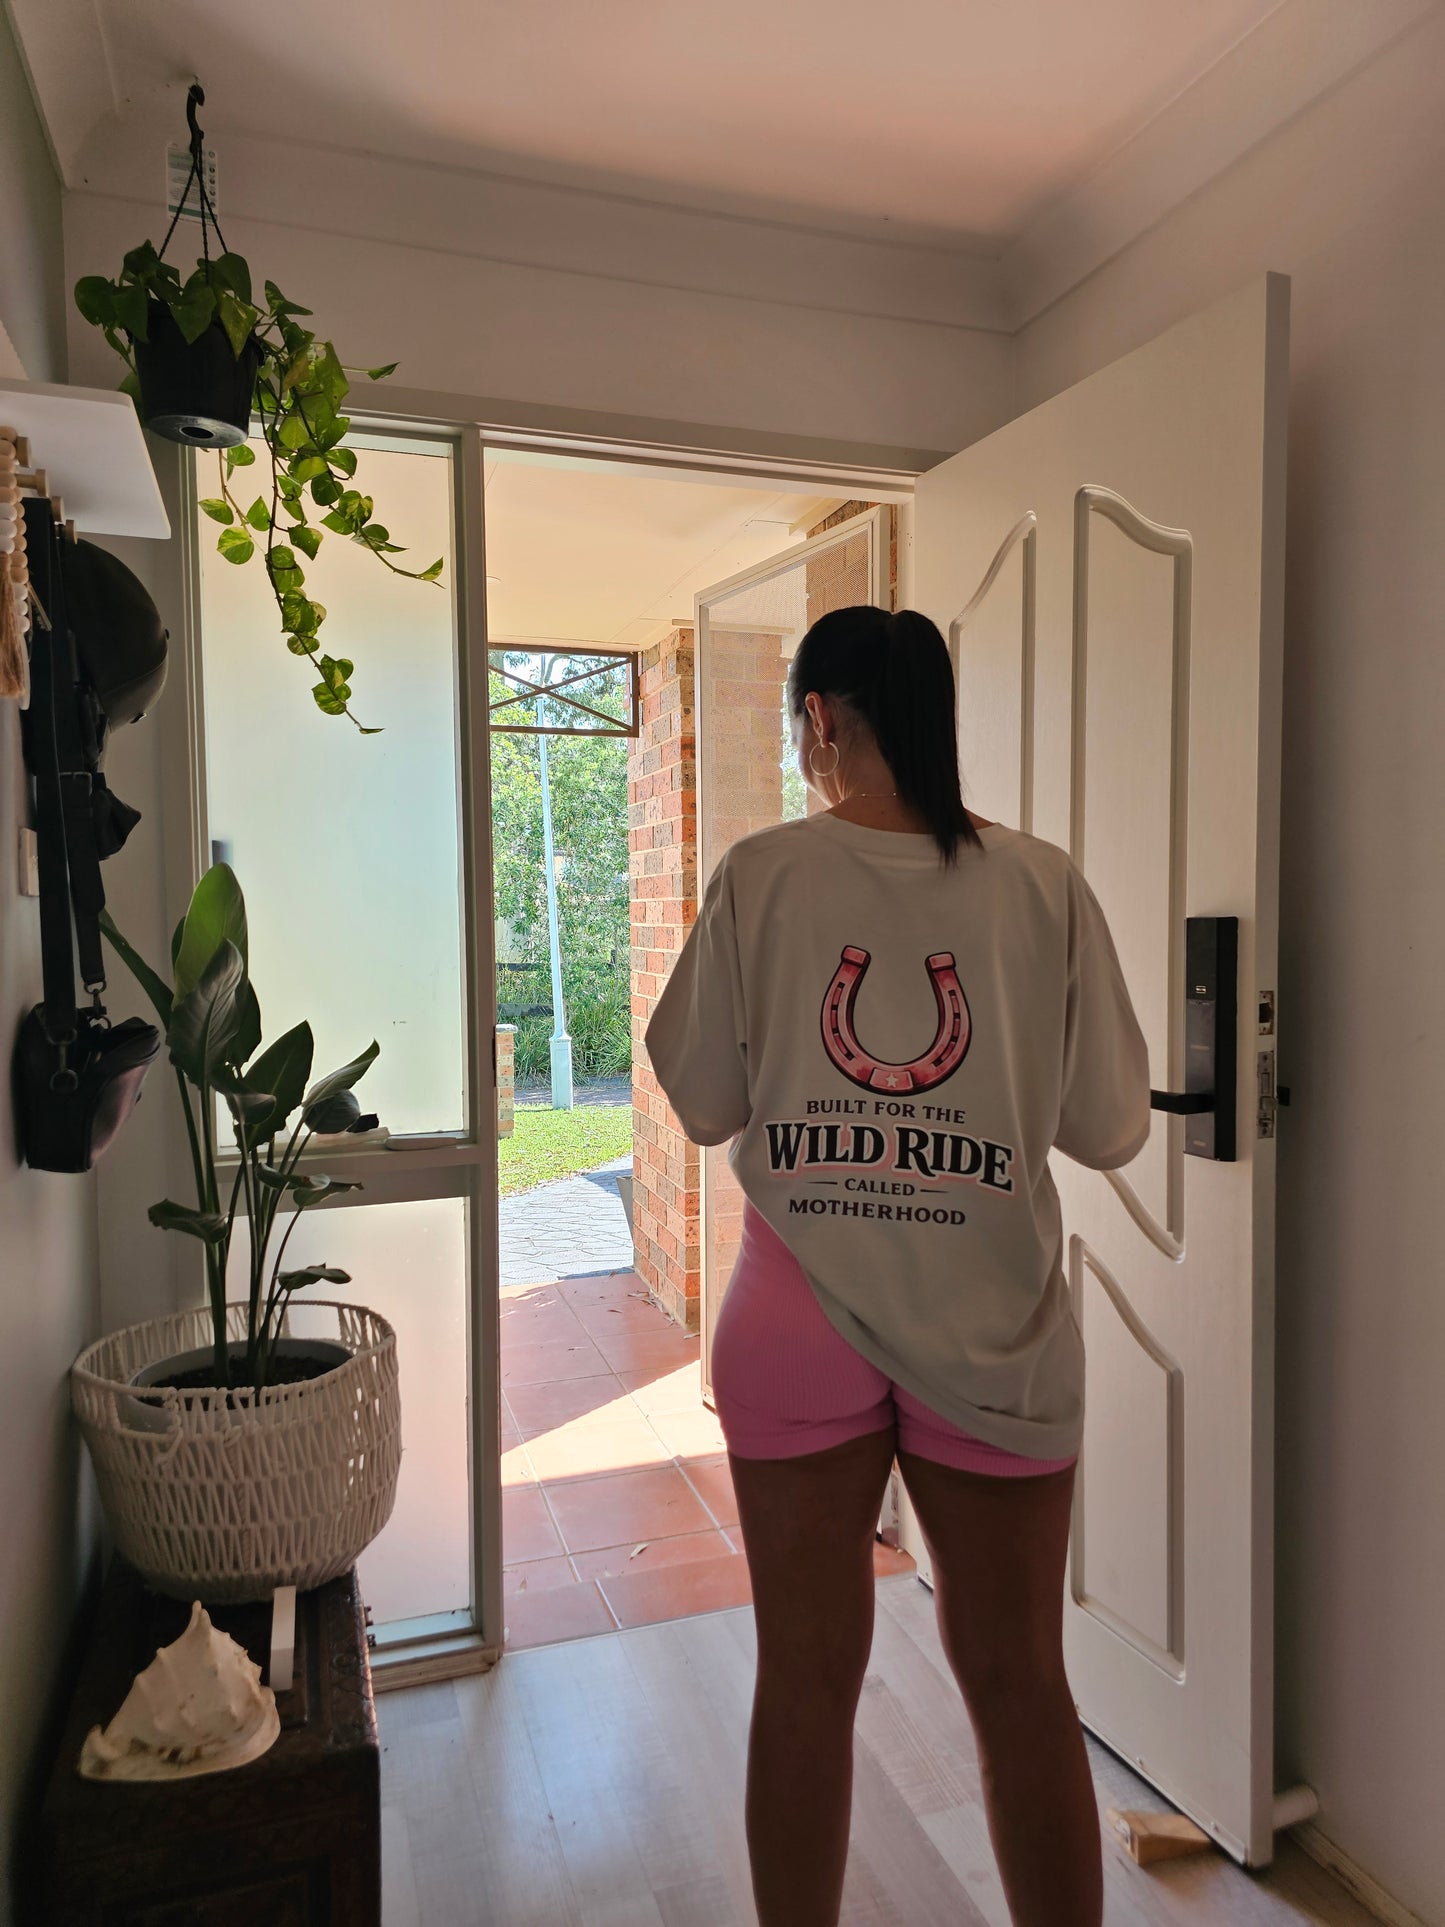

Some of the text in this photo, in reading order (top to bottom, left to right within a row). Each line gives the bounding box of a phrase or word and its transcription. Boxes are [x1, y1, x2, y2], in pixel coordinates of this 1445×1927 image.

[806, 1099, 966, 1124] BUILT FOR THE
[766, 1123, 1013, 1192] WILD RIDE
[844, 1178, 915, 1196] CALLED
[788, 1198, 966, 1225] MOTHERHOOD
